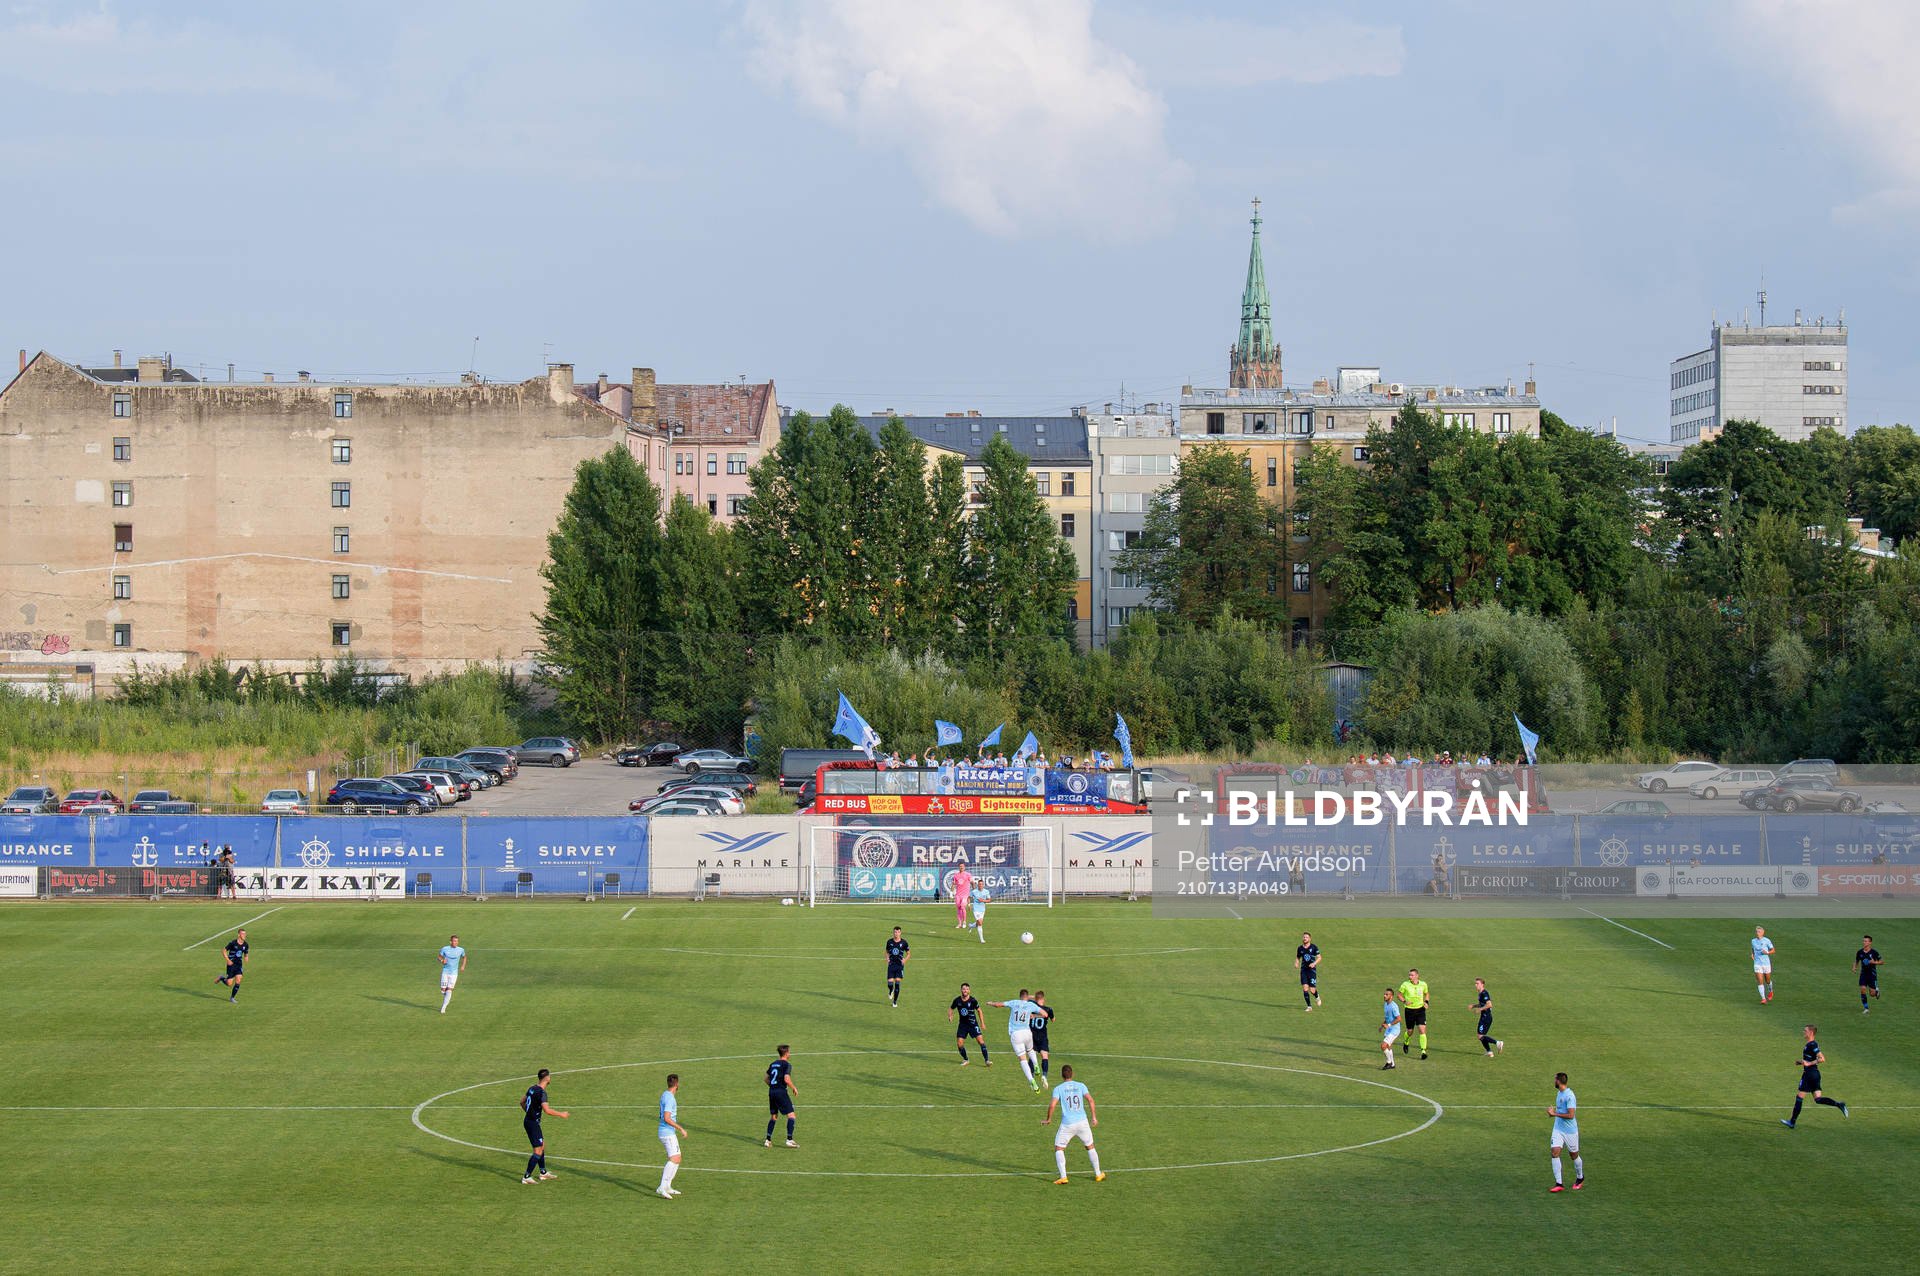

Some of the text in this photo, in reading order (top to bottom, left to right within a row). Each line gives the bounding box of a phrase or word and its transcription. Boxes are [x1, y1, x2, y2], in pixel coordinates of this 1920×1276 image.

[958, 770, 1024, 780] RIGA FC
[825, 800, 866, 808] RED BUS
[949, 798, 973, 811] Riga
[983, 800, 1042, 811] Sightseeing
[2, 844, 73, 856] URANCE
[345, 846, 445, 857] SHIPSALE
[539, 845, 617, 856] SURVEY
[912, 845, 1006, 863] RIGA FC
[1273, 845, 1373, 856] INSURANCE
[1472, 844, 1535, 856] LEGAL
[1643, 844, 1742, 855] SHIPSALE
[1835, 844, 1913, 855] SURVEY
[698, 859, 788, 867] MARINE
[1069, 859, 1160, 867] MARINE
[51, 869, 117, 887] Duvel's
[143, 869, 209, 888] Duvel's
[318, 875, 401, 890] KATZ
[882, 873, 935, 891] JAKO
[974, 876, 1029, 887] RIGA FC
[1464, 876, 1528, 888] LF GROUP
[1555, 876, 1619, 888] LF GROUP
[1669, 877, 1694, 885] RIGA
[1697, 877, 1753, 885] FOOTBALL
[1838, 874, 1907, 885] SPORTLAND
[1014, 1010, 1026, 1022] 14
[770, 1068, 778, 1085] 2
[1066, 1095, 1081, 1110] 19
